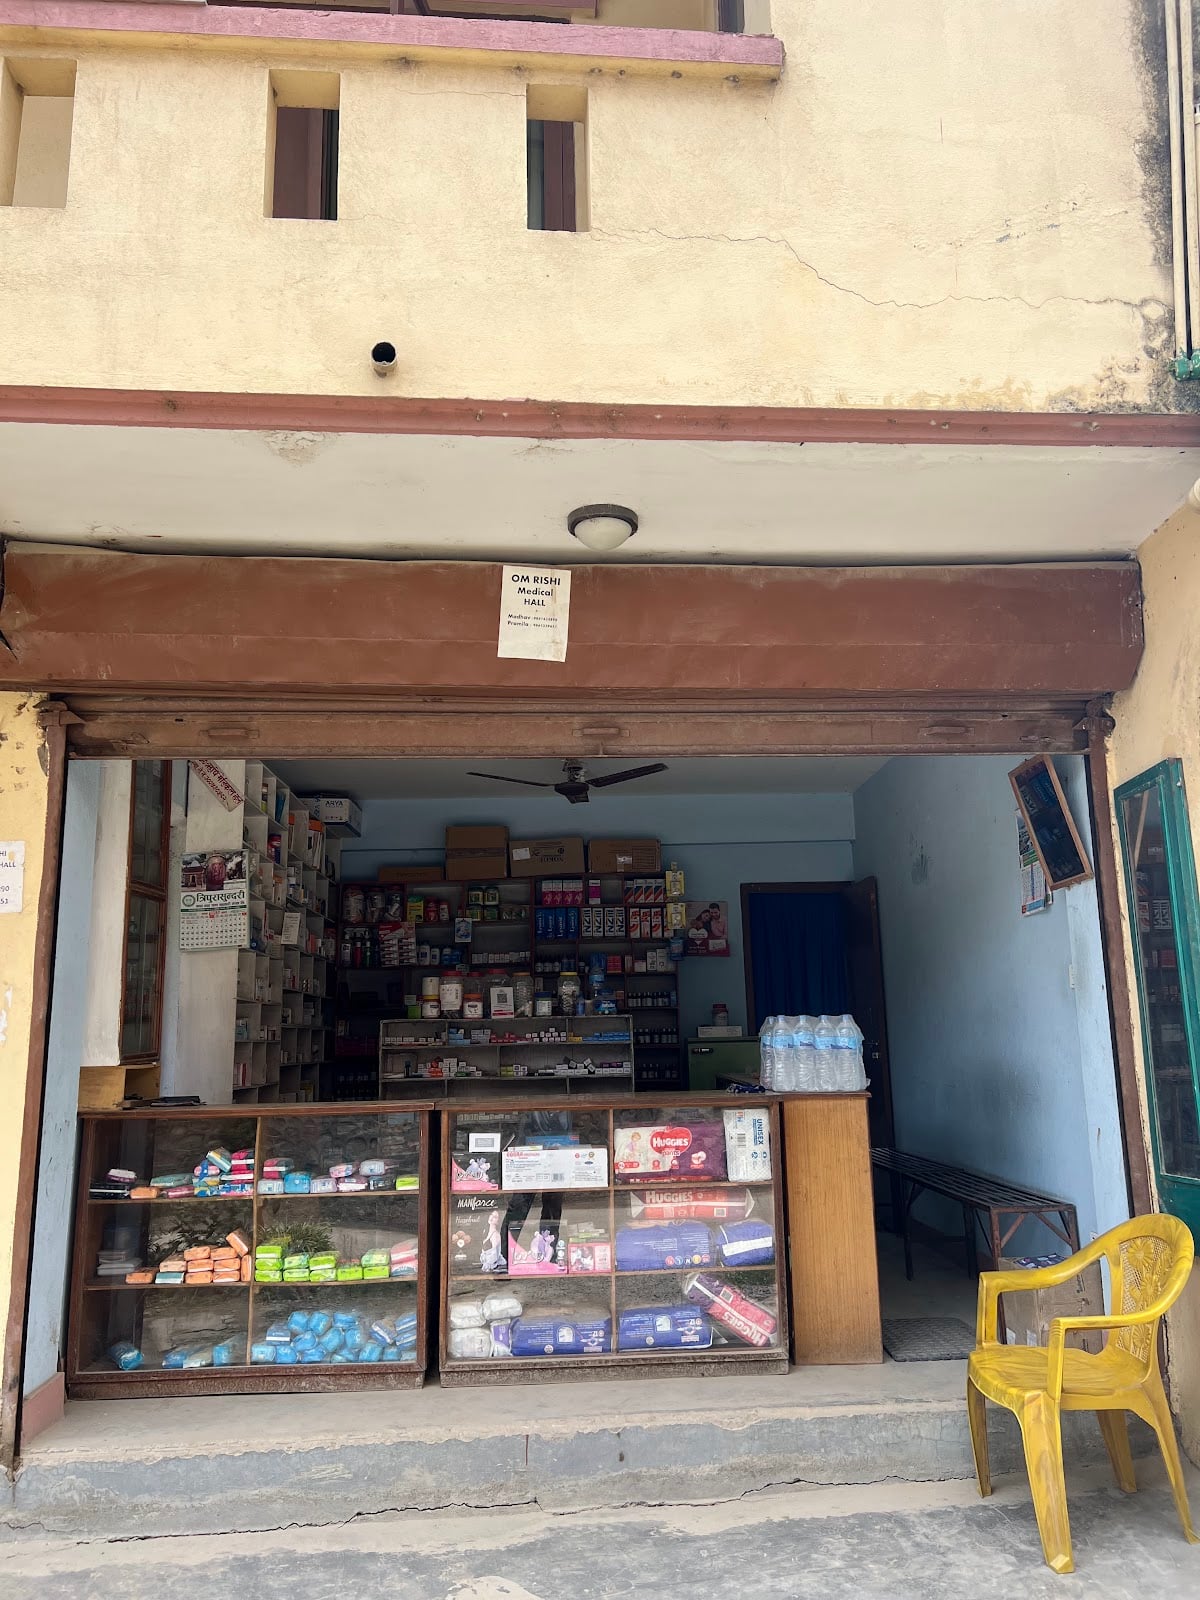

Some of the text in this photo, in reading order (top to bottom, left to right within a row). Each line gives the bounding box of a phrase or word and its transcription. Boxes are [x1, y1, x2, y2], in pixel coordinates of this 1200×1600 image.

[512, 574, 561, 586] OM RISHI
[517, 587, 554, 597] Medical
[524, 598, 546, 607] HALL
[196, 890, 245, 903] त्रिपुरासुन्दरी
[756, 1118, 764, 1145] UNISEX
[652, 1136, 689, 1148] HUGGIES
[645, 1190, 693, 1204] HUGGIES
[721, 1312, 766, 1346] HUGGIES
